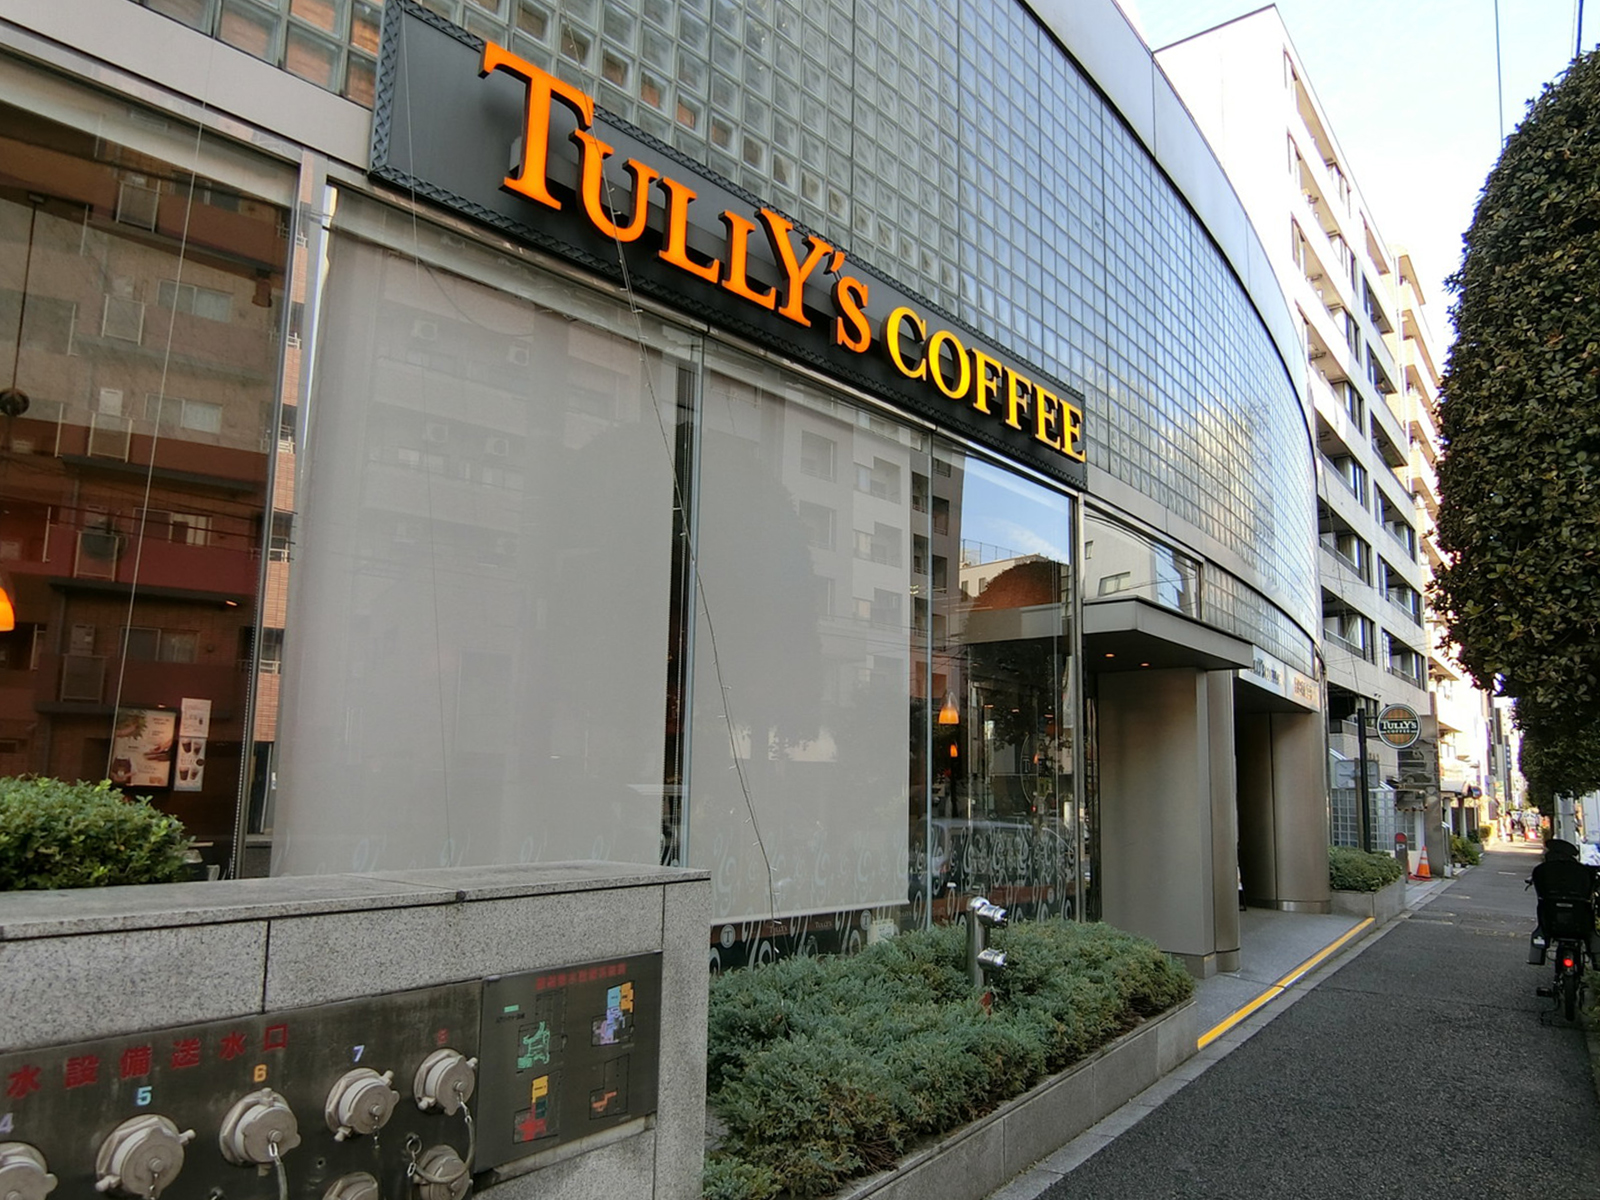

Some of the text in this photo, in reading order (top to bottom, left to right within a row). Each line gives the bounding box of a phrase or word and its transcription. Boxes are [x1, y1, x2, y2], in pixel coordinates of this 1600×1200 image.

[479, 41, 1086, 462] TULLY'S COFFEE
[6, 1023, 289, 1099] 水設備送水口
[352, 1045, 365, 1062] 7
[254, 1064, 267, 1082] 6
[137, 1086, 152, 1105] 5
[0, 1113, 14, 1132] 4
